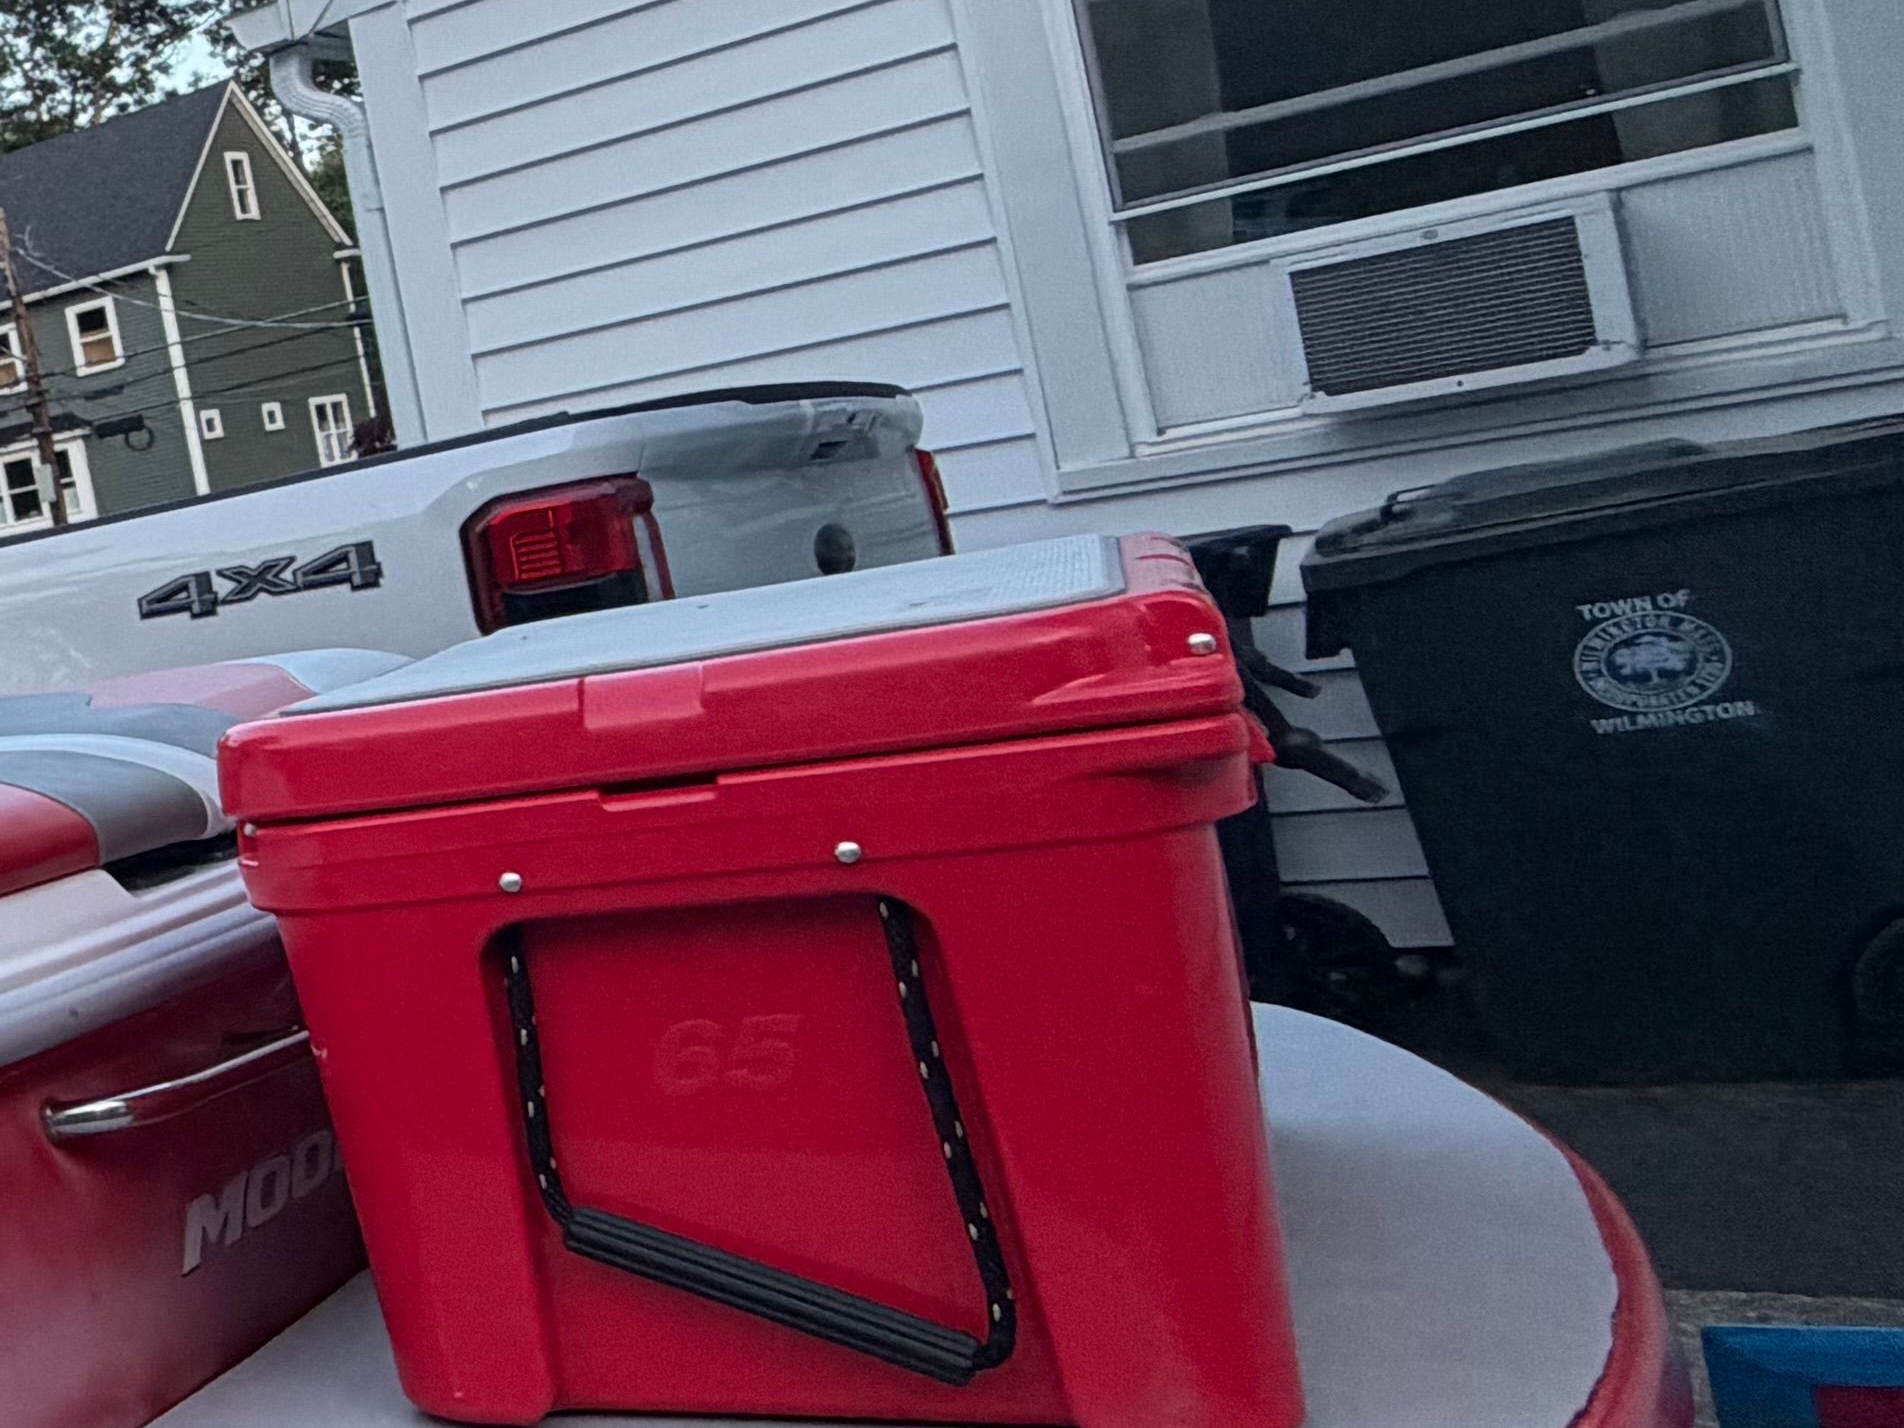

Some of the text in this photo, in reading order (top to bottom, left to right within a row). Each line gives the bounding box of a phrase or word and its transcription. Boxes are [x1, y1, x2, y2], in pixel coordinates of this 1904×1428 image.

[1576, 588, 1690, 621] TOWN OF
[1590, 700, 1755, 735] WILMINGTON
[652, 1013, 804, 1096] 65
[182, 1129, 345, 1276] MOO
